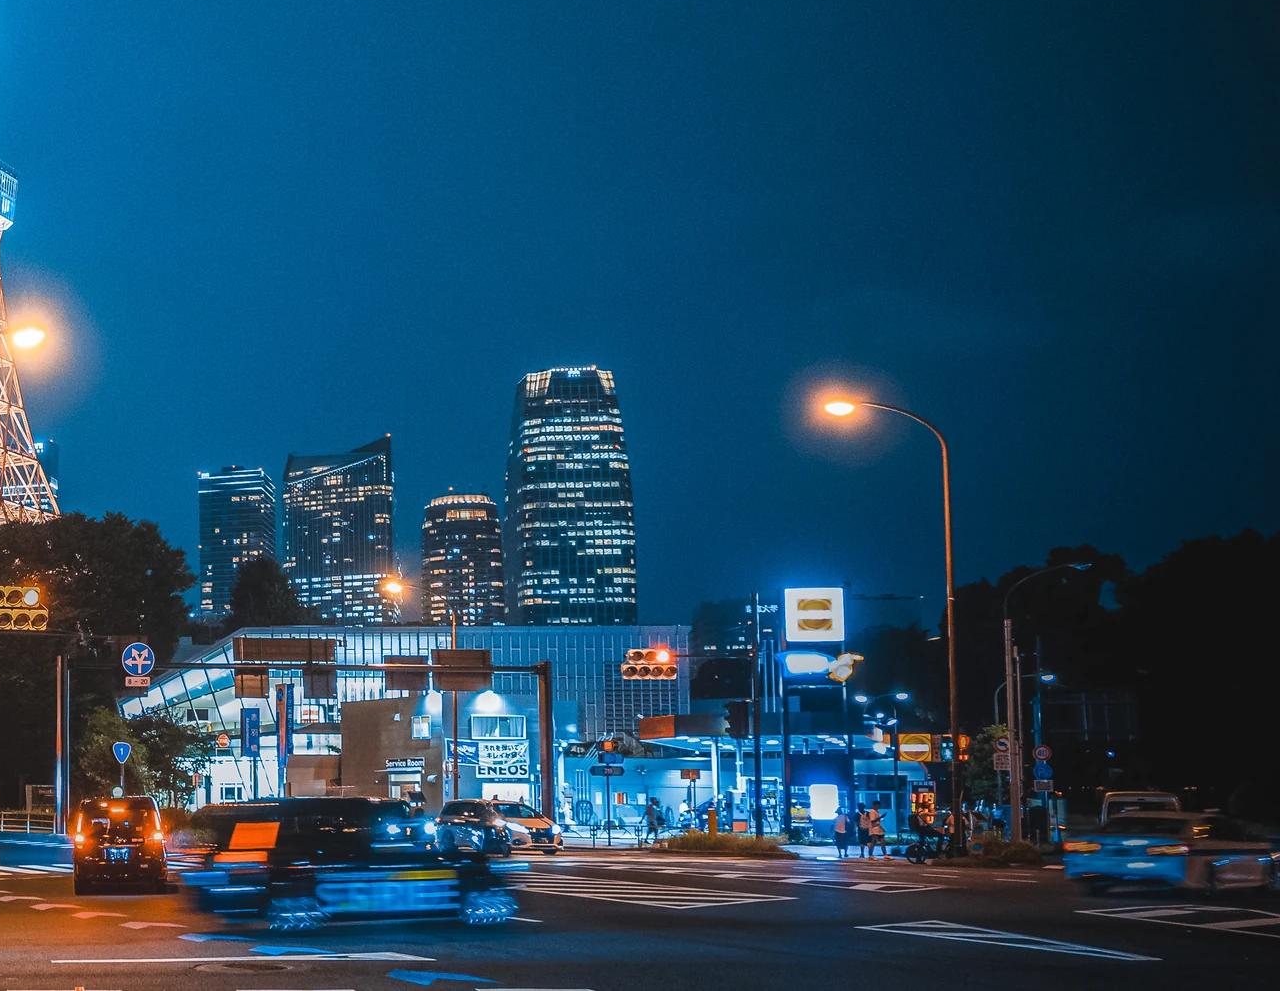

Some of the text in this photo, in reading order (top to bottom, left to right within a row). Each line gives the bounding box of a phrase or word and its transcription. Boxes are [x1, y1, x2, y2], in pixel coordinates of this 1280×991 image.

[119, 747, 124, 756] 1
[385, 758, 424, 767] Service Room
[478, 764, 528, 776] ENEOS
